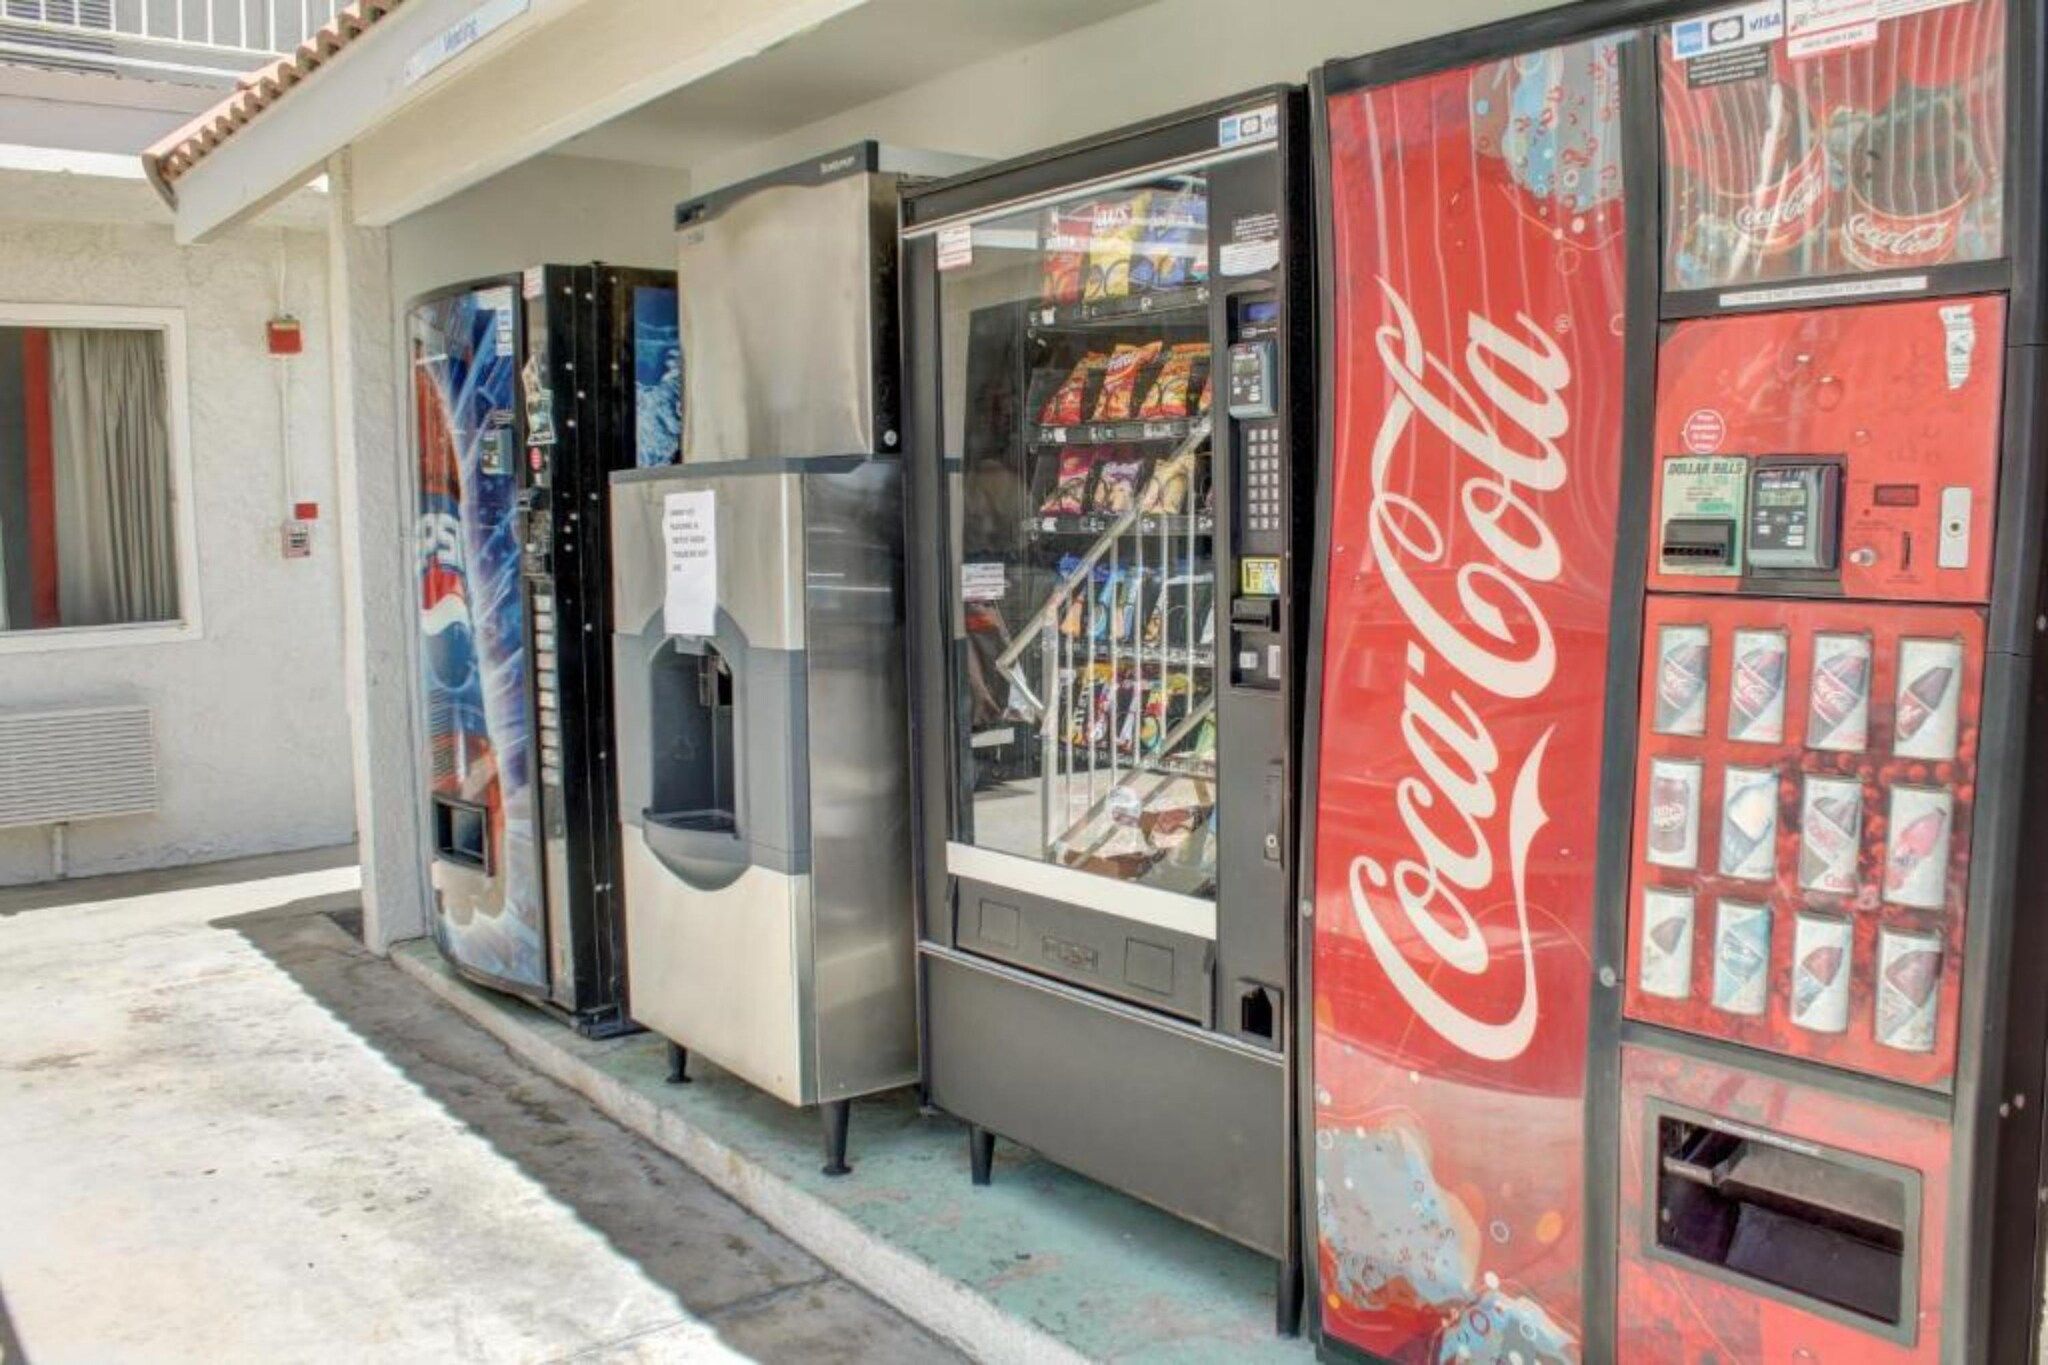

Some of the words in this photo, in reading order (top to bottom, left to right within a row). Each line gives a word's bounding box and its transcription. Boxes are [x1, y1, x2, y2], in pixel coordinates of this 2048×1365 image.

[1749, 13, 1781, 32] VISA
[1667, 462, 1711, 476] DOLLAR
[1711, 462, 1744, 475] BILLS
[1348, 273, 1572, 1062] Coca-Cola
